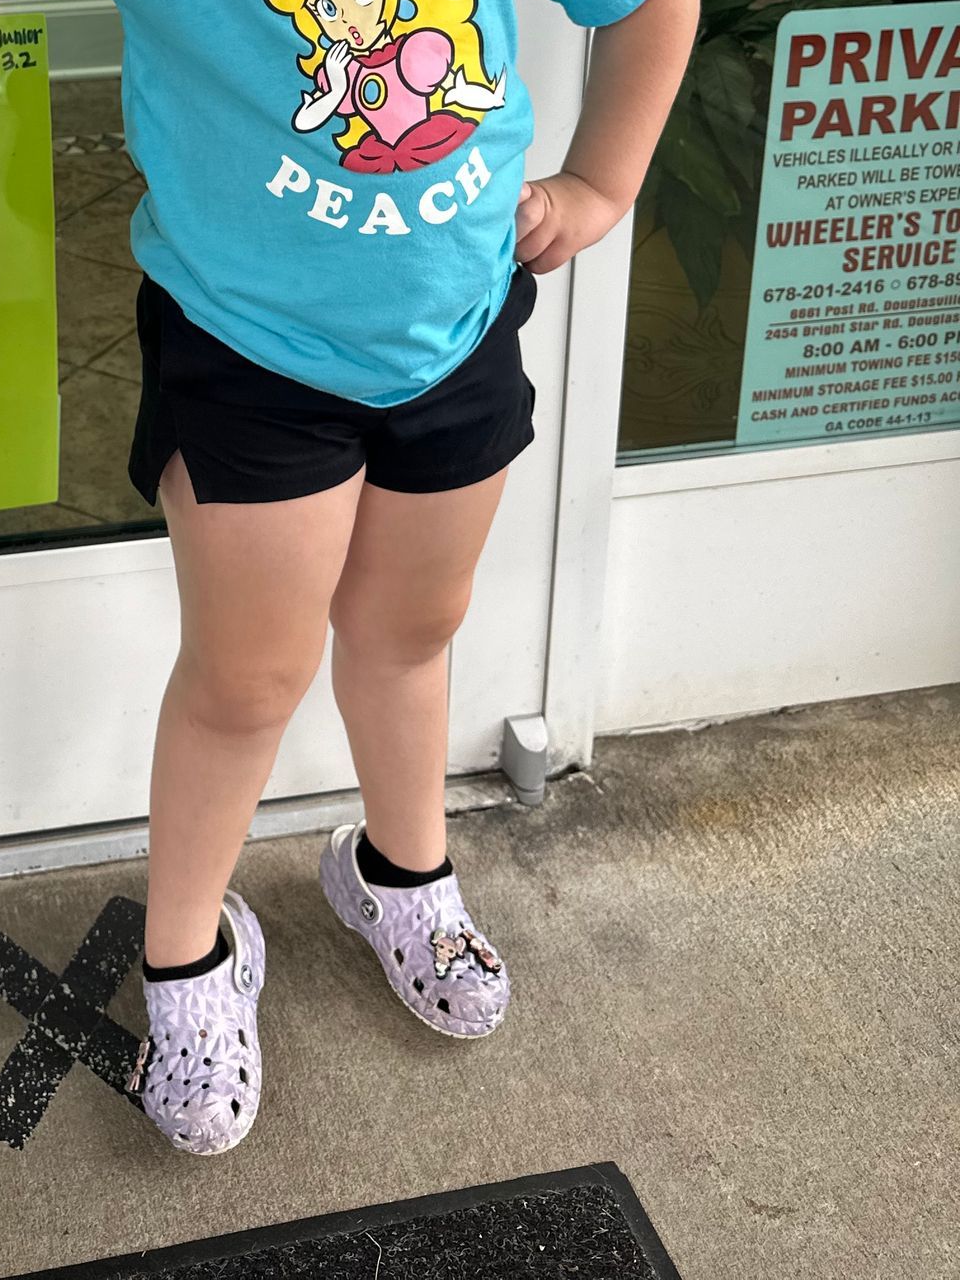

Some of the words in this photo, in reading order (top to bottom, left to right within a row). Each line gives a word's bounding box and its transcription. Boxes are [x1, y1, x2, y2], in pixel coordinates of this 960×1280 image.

[1, 51, 38, 71] 3.2
[773, 149, 846, 167] VEHICLES
[849, 143, 929, 162] ILLEGALLY
[932, 141, 953, 156] OR
[265, 146, 493, 236] PEACH
[797, 172, 858, 189] PARKED
[862, 170, 896, 184] WILL
[900, 167, 920, 182] BE
[825, 195, 845, 211] AT
[847, 190, 916, 209] OWNER'S
[766, 211, 921, 248] WHEELER'S
[842, 239, 957, 273] SERVICE
[763, 279, 885, 303] 678-201-2416
[825, 304, 854, 317] Post
[858, 302, 879, 315] Rd.
[803, 322, 845, 337] Bright
[849, 320, 879, 333] Star
[883, 318, 903, 330] Rd.
[803, 341, 844, 358] 8:00
[849, 338, 880, 354] AM
[898, 332, 938, 349] 6:00
[944, 330, 960, 345] P
[785, 362, 847, 379] MINIMUM
[851, 356, 903, 373] TOWING
[907, 353, 931, 368] FEE
[752, 385, 814, 402] MINIMUM
[818, 379, 880, 397] STORAGE
[883, 376, 908, 390] FEE
[911, 371, 953, 388] $15.00
[751, 408, 787, 422] CASH
[791, 405, 818, 418] AND
[822, 398, 890, 415] CERTIFIED
[893, 392, 937, 408] FUNDS
[825, 421, 843, 433] GA
[847, 416, 883, 431] CODE
